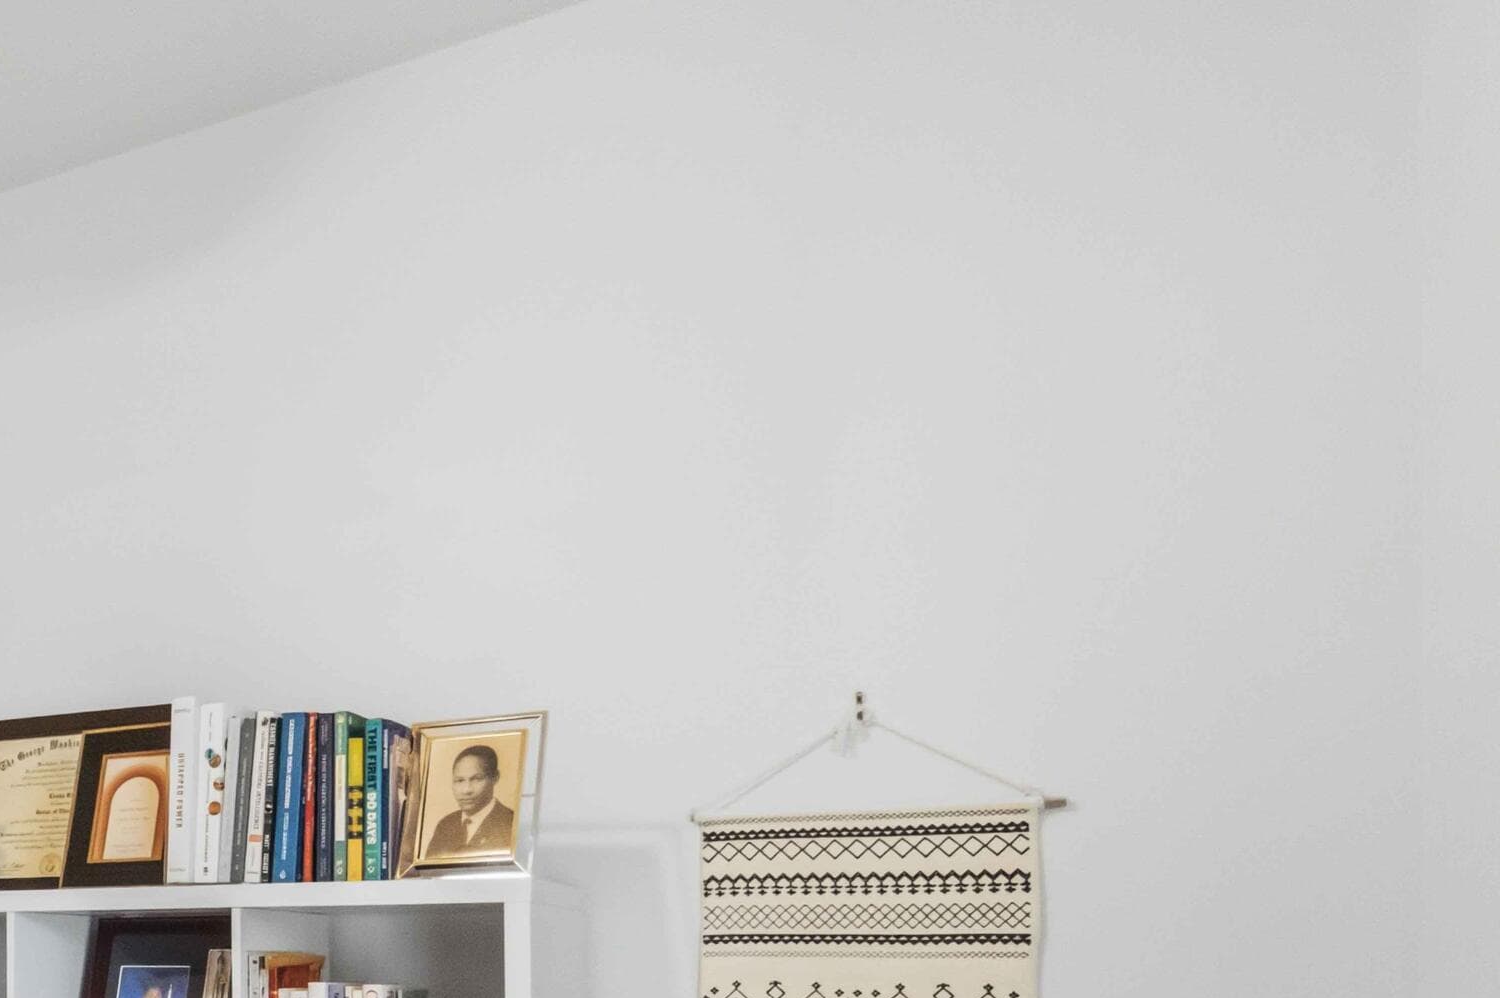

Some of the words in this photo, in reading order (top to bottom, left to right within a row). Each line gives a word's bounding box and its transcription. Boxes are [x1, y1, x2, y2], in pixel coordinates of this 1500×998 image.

[368, 728, 376, 753] THE
[0, 758, 14, 771] The
[17, 746, 45, 760] George
[368, 756, 376, 789] FIRST
[368, 792, 376, 809] 90
[368, 812, 376, 844] DAYS
